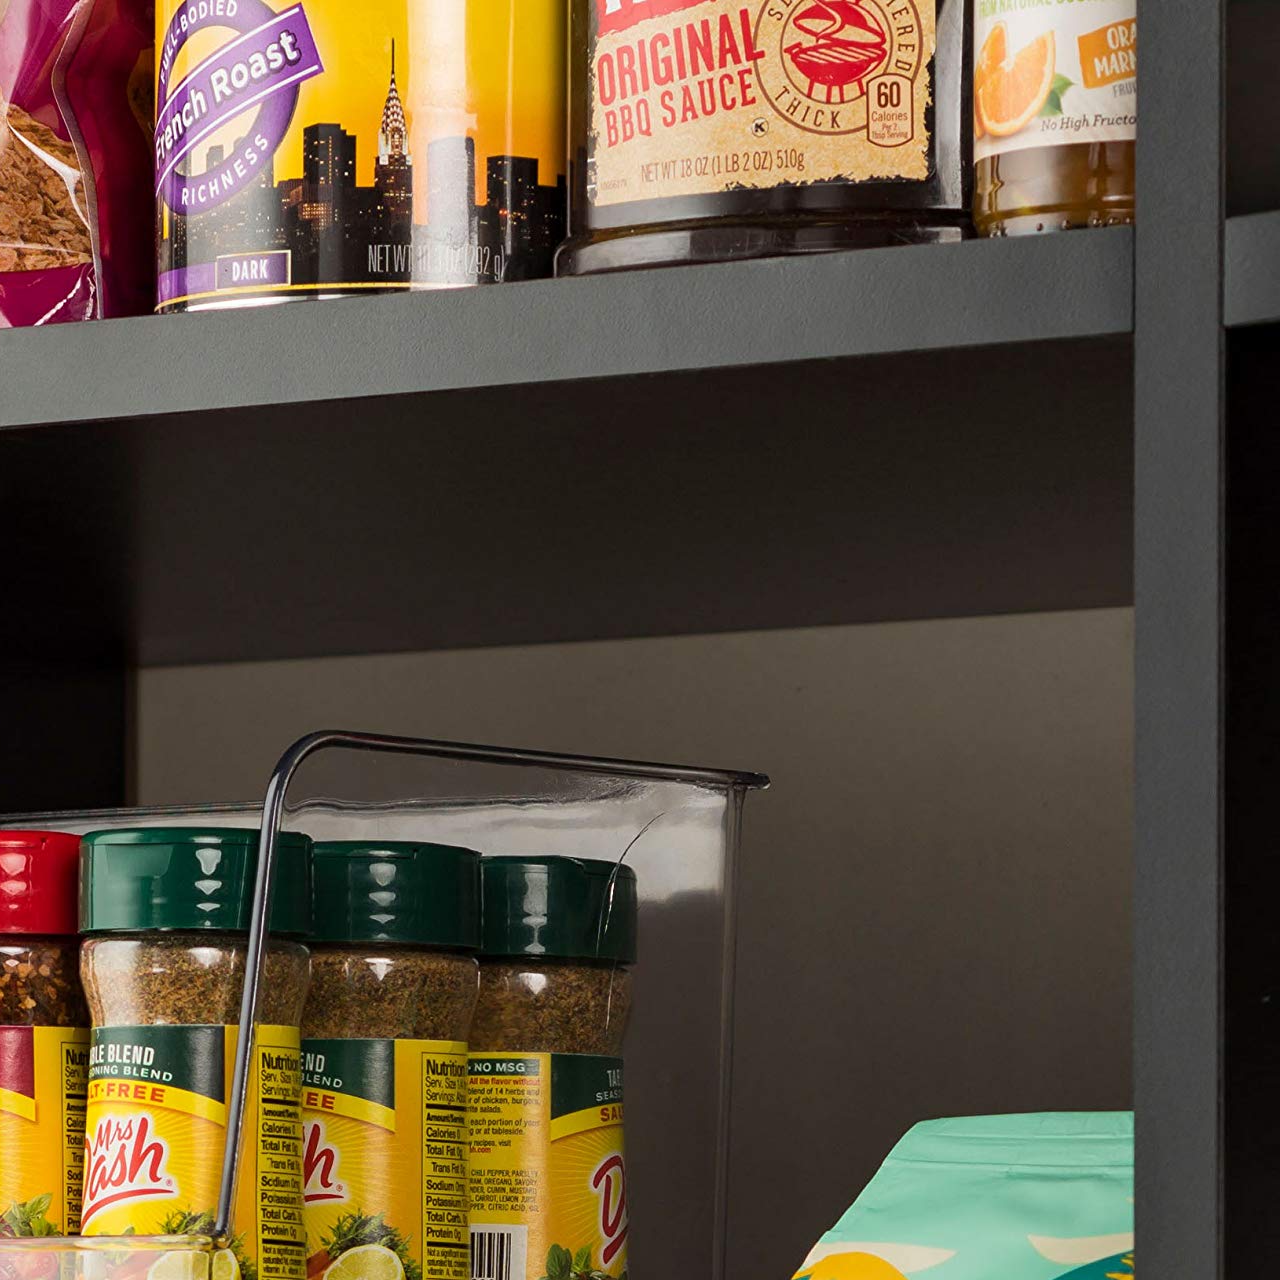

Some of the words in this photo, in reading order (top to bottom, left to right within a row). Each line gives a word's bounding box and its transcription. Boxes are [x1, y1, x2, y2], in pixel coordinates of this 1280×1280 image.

[597, 8, 765, 106] ORIGINAL
[155, 89, 208, 170] French
[210, 31, 301, 104] Roast
[605, 98, 652, 148] BBQ
[660, 68, 757, 128] SAUCE
[775, 85, 840, 128] THICK
[877, 81, 901, 108] 60
[871, 110, 908, 122] Calories
[1060, 115, 1089, 131] High
[181, 134, 269, 206] RICHNESS
[641, 163, 659, 182] NET
[681, 159, 692, 178] 18
[695, 157, 709, 176] OZ
[725, 153, 739, 174] LB
[776, 149, 805, 172] 510g
[231, 258, 269, 283] DARK
[108, 1045, 155, 1066] BLEND
[474, 1062, 491, 1073] NO
[495, 1062, 526, 1073] MSG
[123, 1067, 174, 1082] BLEND
[95, 1118, 133, 1152] Mrs
